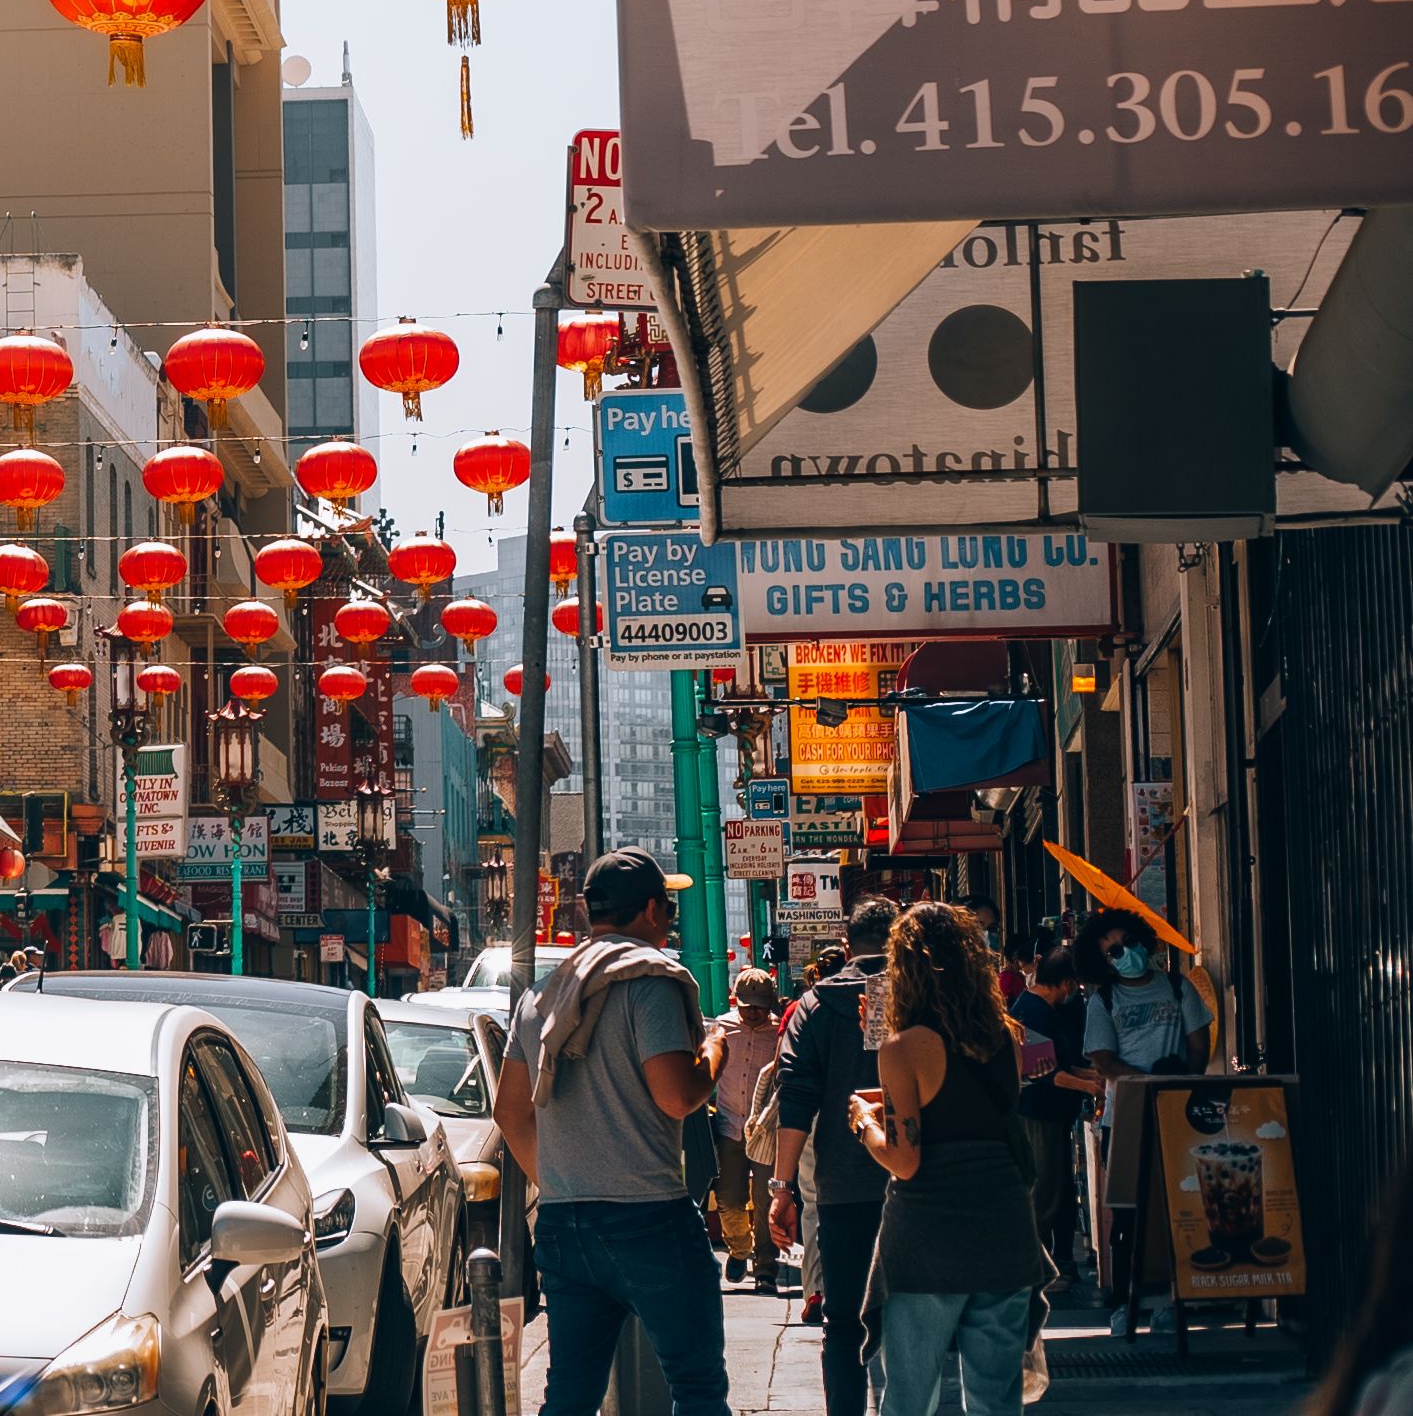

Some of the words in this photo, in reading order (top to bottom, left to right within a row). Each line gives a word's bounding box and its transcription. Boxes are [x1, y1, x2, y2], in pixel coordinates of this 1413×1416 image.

[579, 137, 622, 181] NO
[585, 192, 604, 224] 2
[608, 208, 623, 225] A.
[579, 252, 644, 271] INCLUDI
[586, 282, 644, 301] STREET
[607, 407, 656, 436] Pay
[661, 404, 692, 429] he
[613, 541, 658, 568] Pay
[666, 539, 698, 566] by
[614, 565, 707, 588] License
[615, 589, 679, 613] Plate
[766, 582, 870, 616] GIFTS
[885, 581, 908, 613] &
[923, 577, 1046, 612] HERBS
[620, 621, 728, 643] 44409003
[610, 653, 625, 663] Pay
[628, 652, 640, 663] by
[642, 652, 669, 662] phone
[683, 652, 693, 660] at
[694, 650, 741, 661] paystation
[795, 643, 847, 664] BROKEN?
[850, 643, 867, 663] WE
[870, 643, 888, 663] FIX
[797, 671, 871, 694] 手機維修
[799, 743, 824, 761] CASH
[826, 743, 845, 761] FOR
[846, 742, 871, 761] YOUR
[873, 742, 895, 760] IPHO
[320, 762, 348, 774] Peking
[135, 778, 158, 791] NLY
[159, 777, 174, 789] IN
[751, 785, 769, 793] Pay
[770, 784, 786, 792] here
[119, 790, 179, 803] CINATOWN
[139, 803, 161, 814] INC.
[124, 824, 159, 837] FTS
[161, 823, 174, 834] &
[727, 822, 742, 837] NO
[744, 824, 780, 837] PARKING
[793, 821, 852, 830] TASTI
[122, 840, 176, 852] SUVENIR
[186, 843, 217, 859] OW
[730, 843, 737, 854] 2
[760, 842, 767, 853] 6
[177, 864, 212, 876] EAFOOD
[216, 864, 267, 875] RESRANT
[819, 874, 840, 891] TW
[777, 909, 841, 921] WASHINGTON
